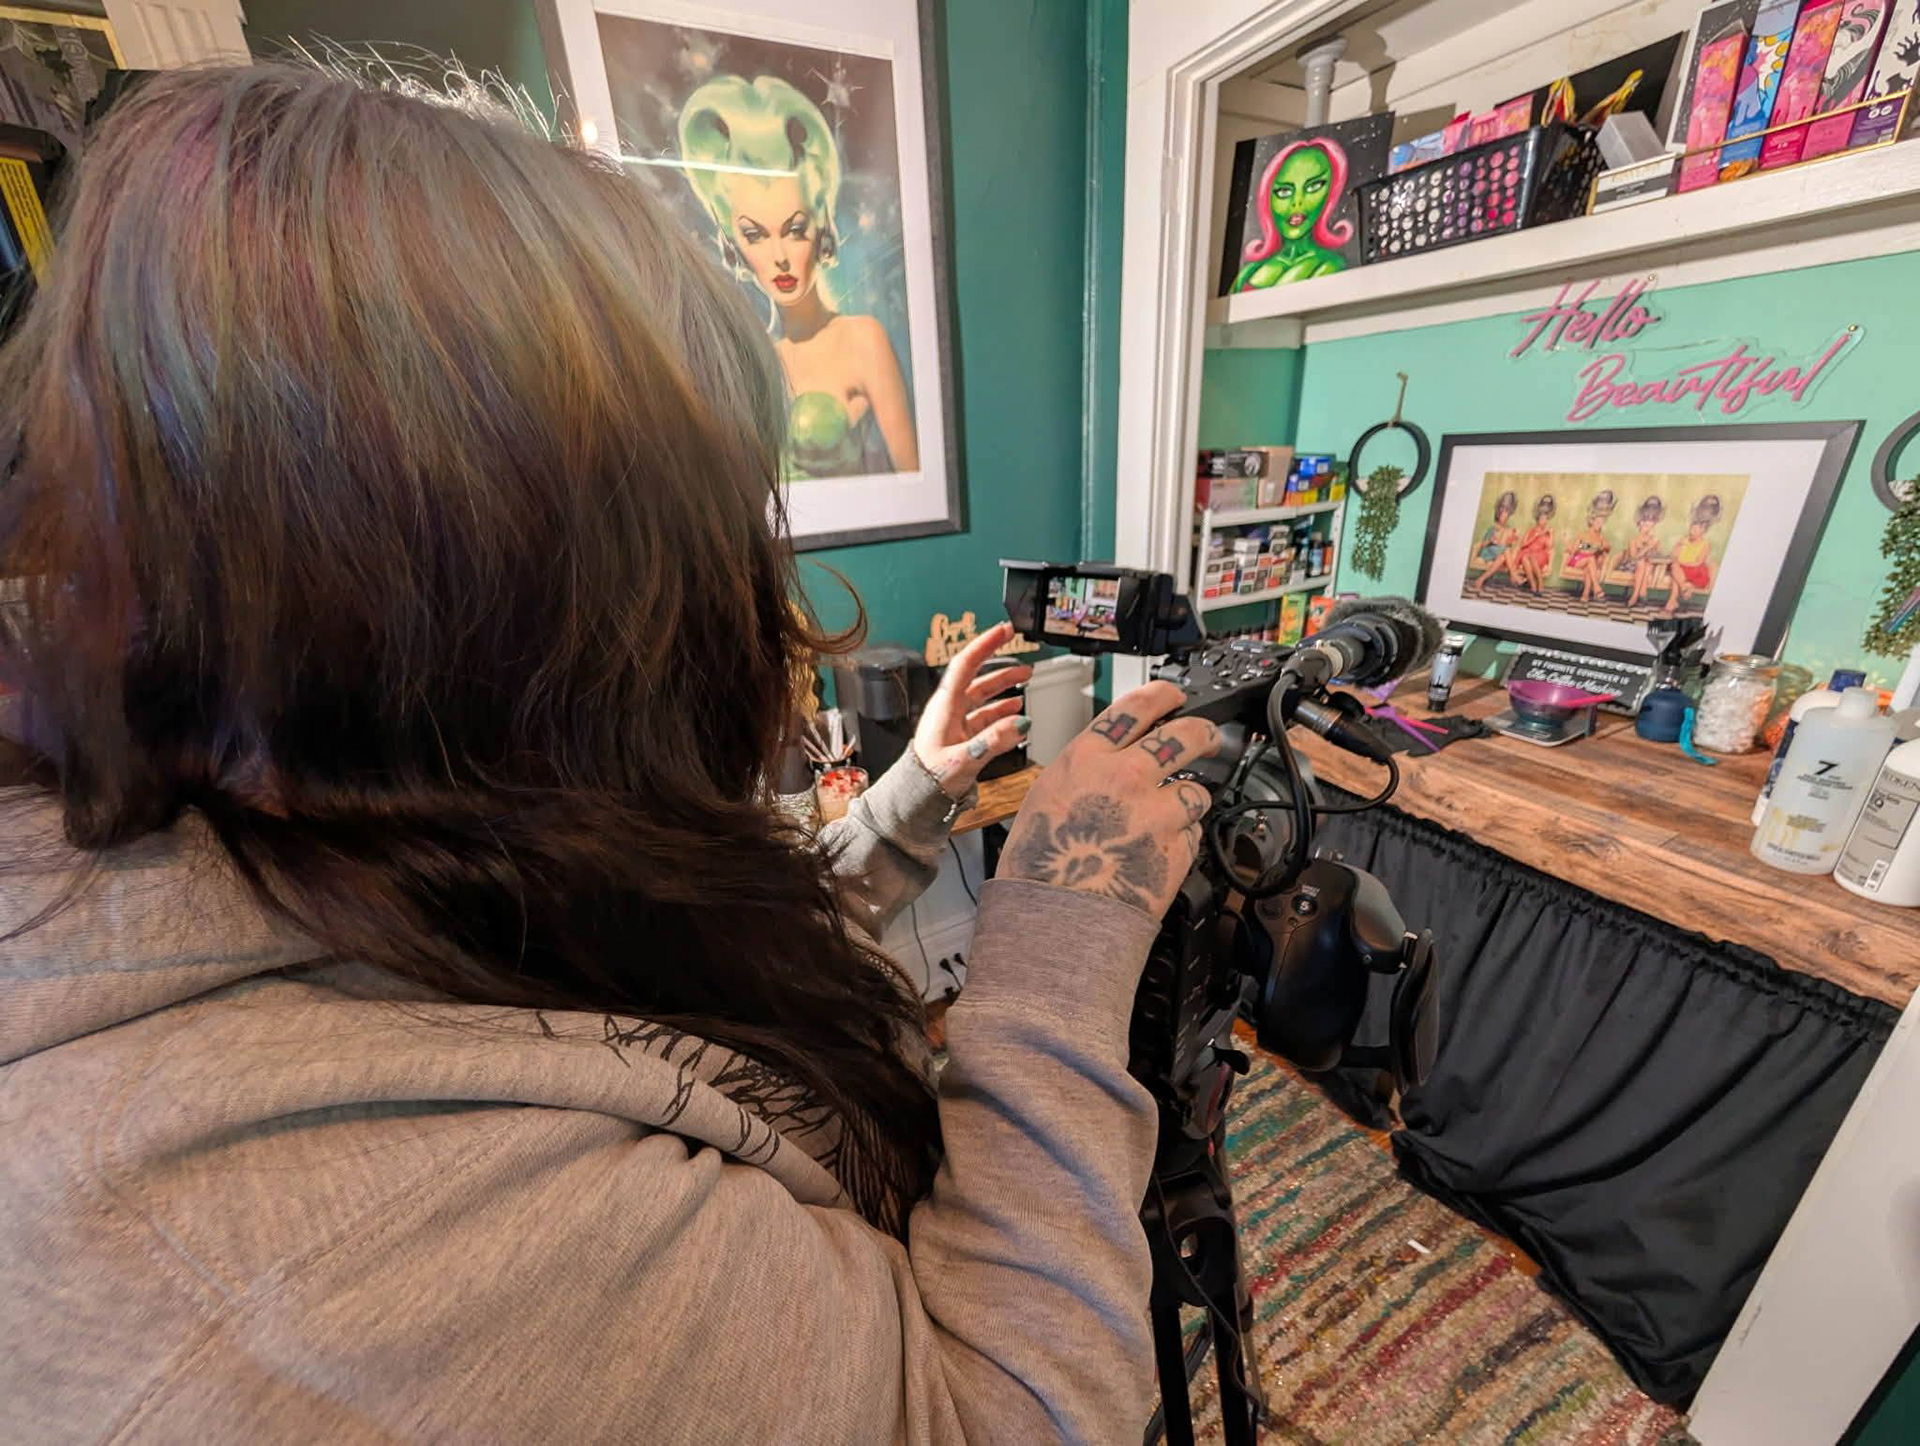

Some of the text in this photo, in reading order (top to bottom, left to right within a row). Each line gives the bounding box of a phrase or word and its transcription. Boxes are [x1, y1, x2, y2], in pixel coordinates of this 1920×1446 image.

[1510, 278, 1661, 357] Hello
[1565, 332, 1851, 422] Beautiful
[1526, 667, 1547, 681] The
[1546, 671, 1577, 689] Coffee
[1576, 668, 1620, 683] COWORKER
[1620, 676, 1631, 685] IS
[1815, 760, 1838, 775] 7
